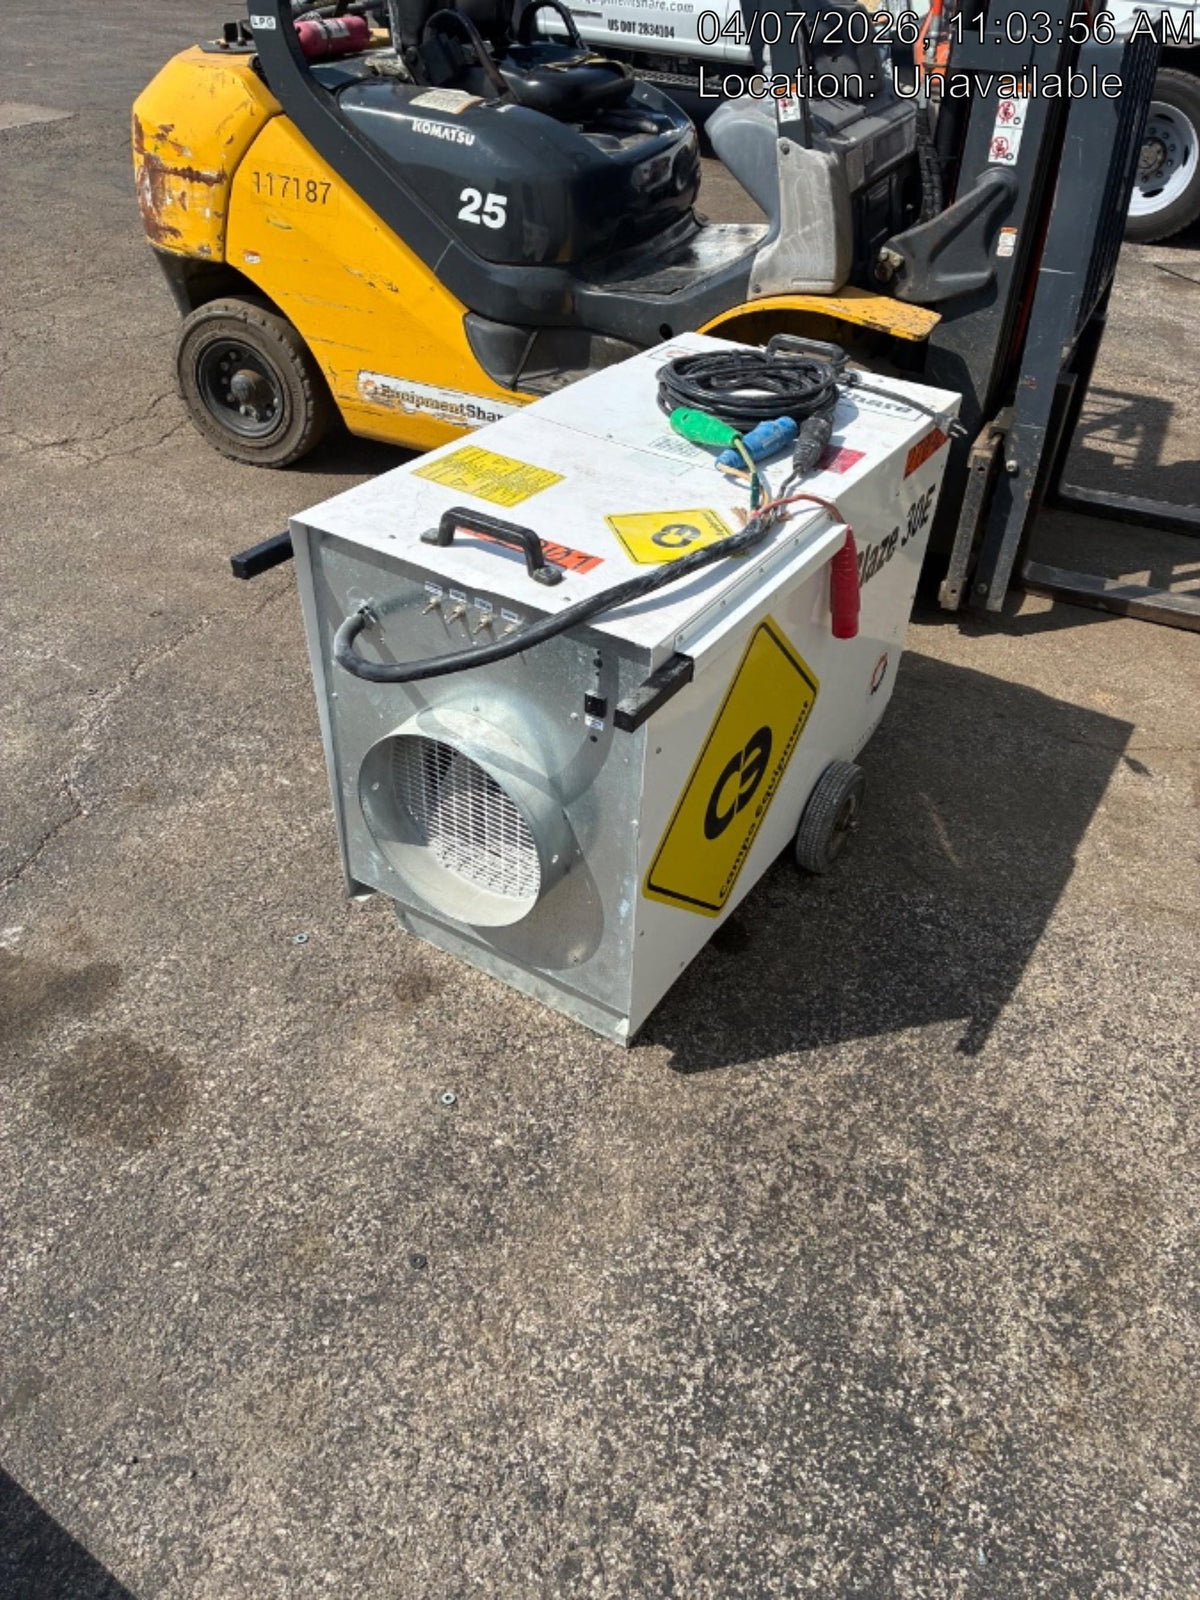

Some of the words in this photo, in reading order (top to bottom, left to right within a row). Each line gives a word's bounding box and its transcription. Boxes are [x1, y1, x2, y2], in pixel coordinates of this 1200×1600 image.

[251, 16, 275, 27] LPG
[608, 19, 619, 32] US
[620, 20, 636, 34] DOT
[411, 118, 476, 146] KOMATSU
[253, 171, 332, 205] 117187
[457, 187, 507, 229] 25
[857, 525, 900, 588] laze
[719, 822, 756, 898] Campo
